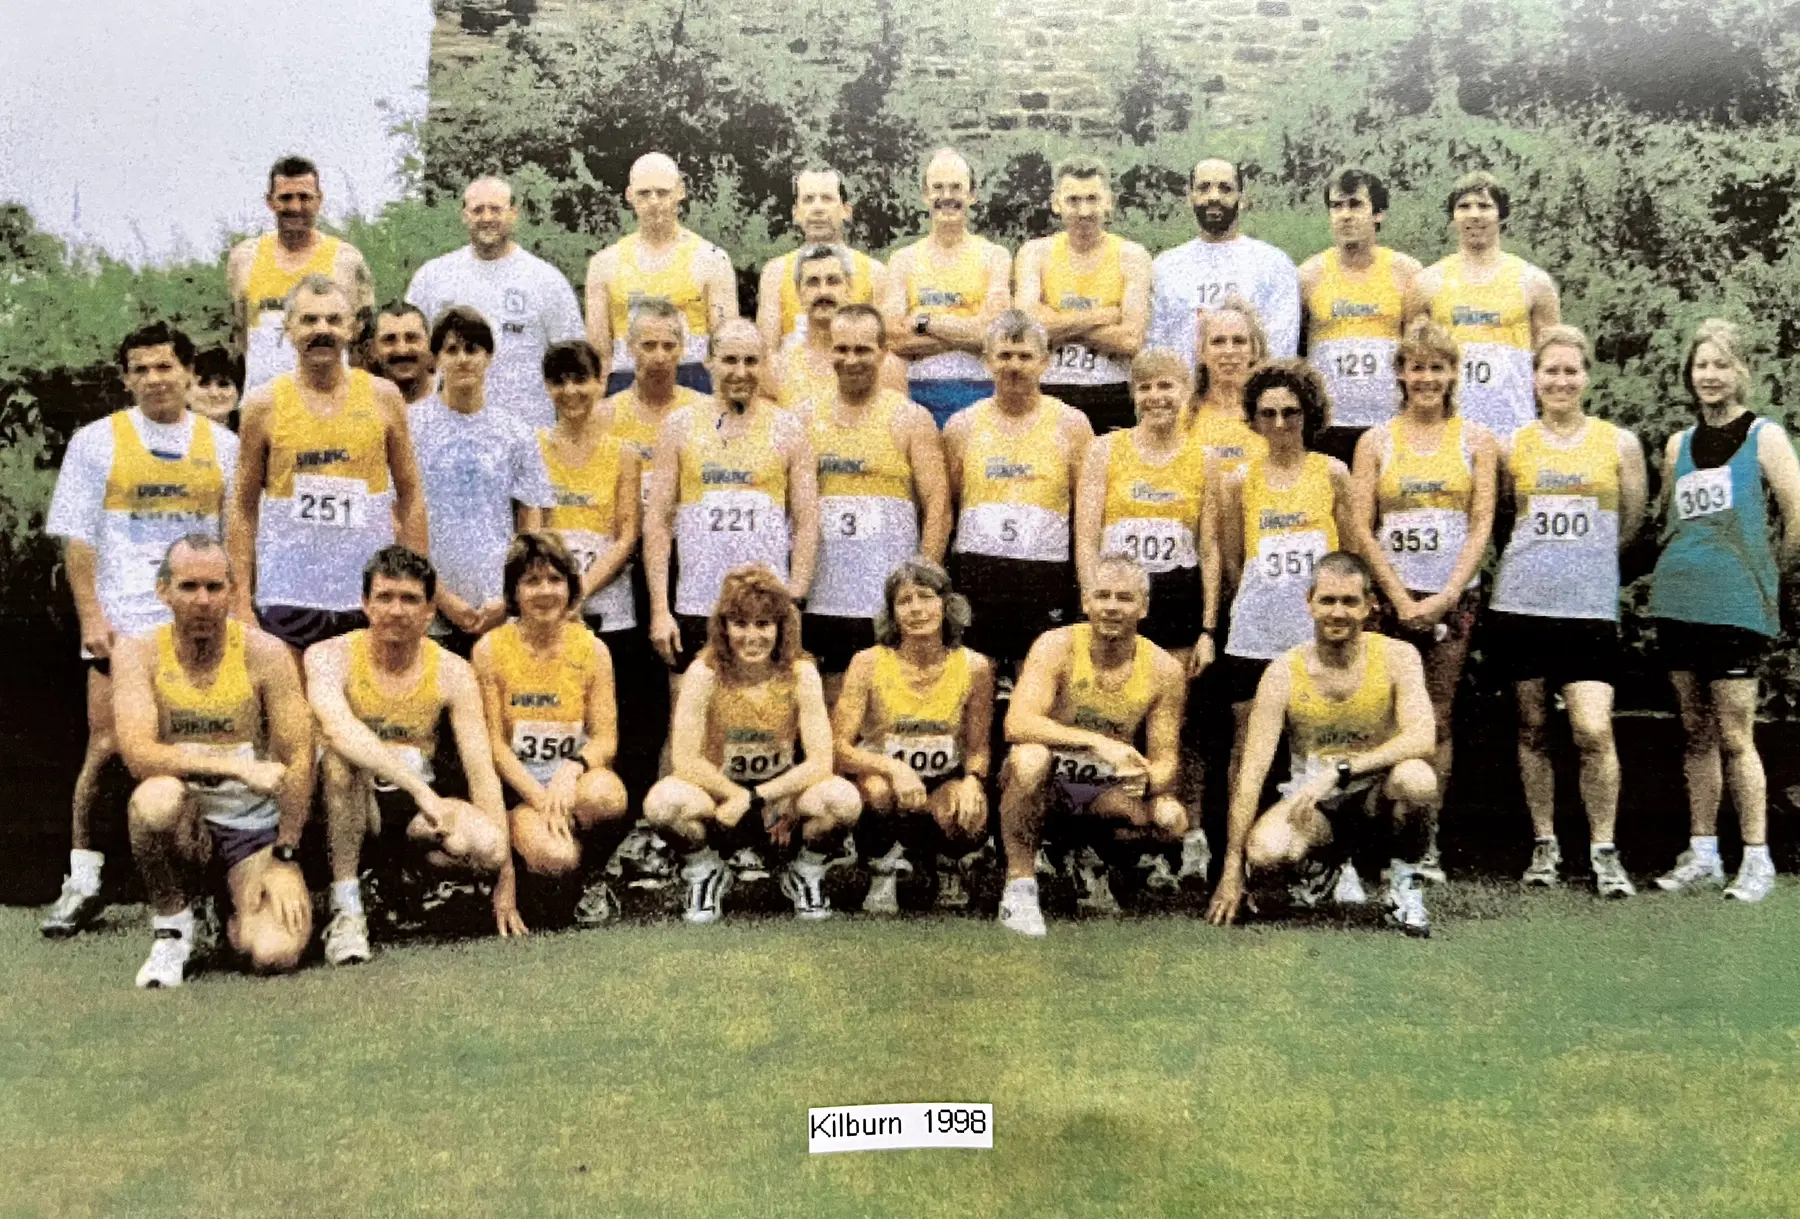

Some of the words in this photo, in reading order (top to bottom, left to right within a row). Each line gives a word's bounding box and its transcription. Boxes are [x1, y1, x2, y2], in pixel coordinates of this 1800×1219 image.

[1336, 353, 1377, 377] 129
[1464, 361, 1491, 384] 10
[301, 494, 351, 527] 251
[1679, 484, 1726, 515] 303
[710, 508, 755, 532] 221
[841, 512, 857, 536] 3
[1002, 518, 1018, 542] 5
[1534, 511, 1590, 537] 300
[1125, 534, 1177, 561] 302
[1390, 527, 1439, 553] 353
[1266, 550, 1315, 577] 351
[518, 735, 576, 761] 350
